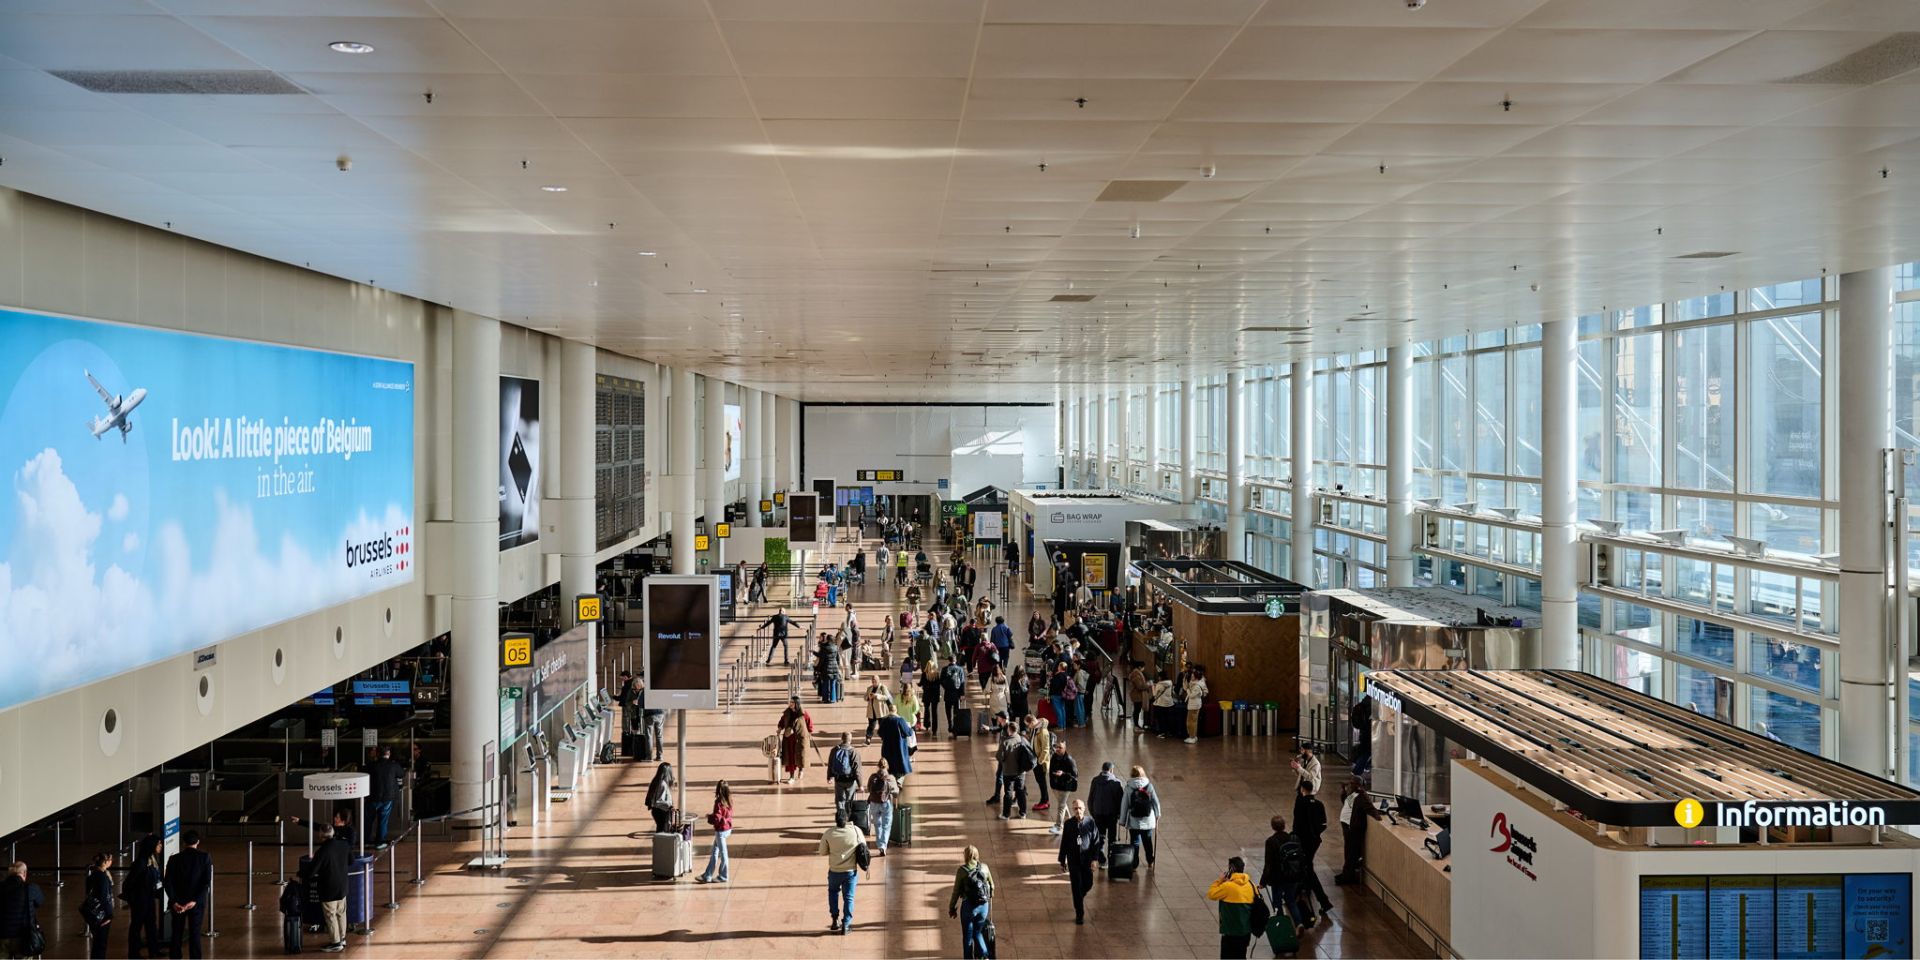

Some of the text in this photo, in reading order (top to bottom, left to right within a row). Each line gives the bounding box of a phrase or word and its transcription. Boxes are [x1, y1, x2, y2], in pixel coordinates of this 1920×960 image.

[172, 415, 372, 464] Look! A little piece of Belgium
[257, 464, 316, 498] in the air.
[346, 531, 392, 568] brussels
[370, 564, 392, 578] AIRLINES
[581, 605, 597, 617] 06
[508, 648, 527, 661] 05
[417, 691, 432, 699] 5.1
[1366, 678, 1402, 714] Information
[308, 783, 342, 791] brussels
[1717, 800, 1885, 827] Information
